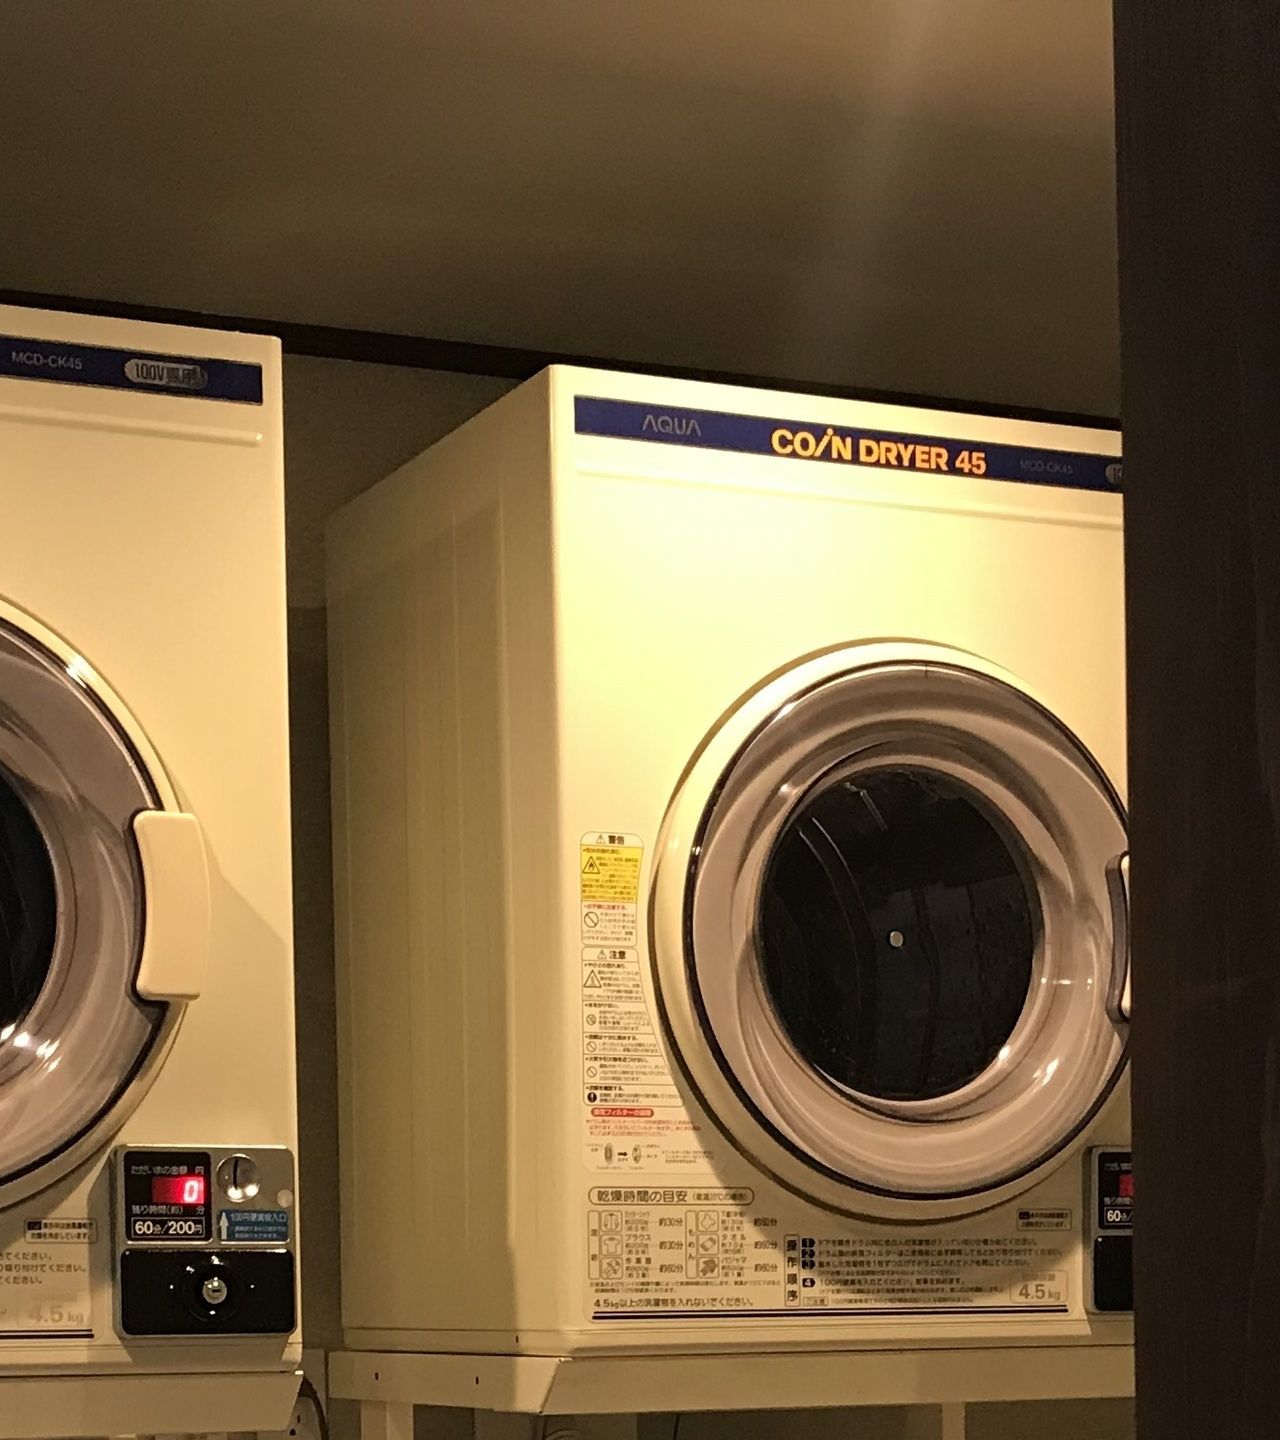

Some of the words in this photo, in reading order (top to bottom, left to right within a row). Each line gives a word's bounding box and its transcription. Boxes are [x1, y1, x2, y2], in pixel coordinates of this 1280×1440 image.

[11, 351, 83, 370] MCD-CK45
[642, 413, 702, 437] AQUA
[859, 440, 949, 472] DRYER
[954, 450, 987, 475] 45
[608, 949, 627, 960] 注意
[194, 1166, 205, 1175] 円
[183, 1180, 200, 1202] 0
[597, 1190, 688, 1203] 乾燥時間の目安
[195, 1205, 205, 1215] 分
[1018, 1284, 1045, 1301] 4.5
[1048, 1287, 1061, 1302] kg
